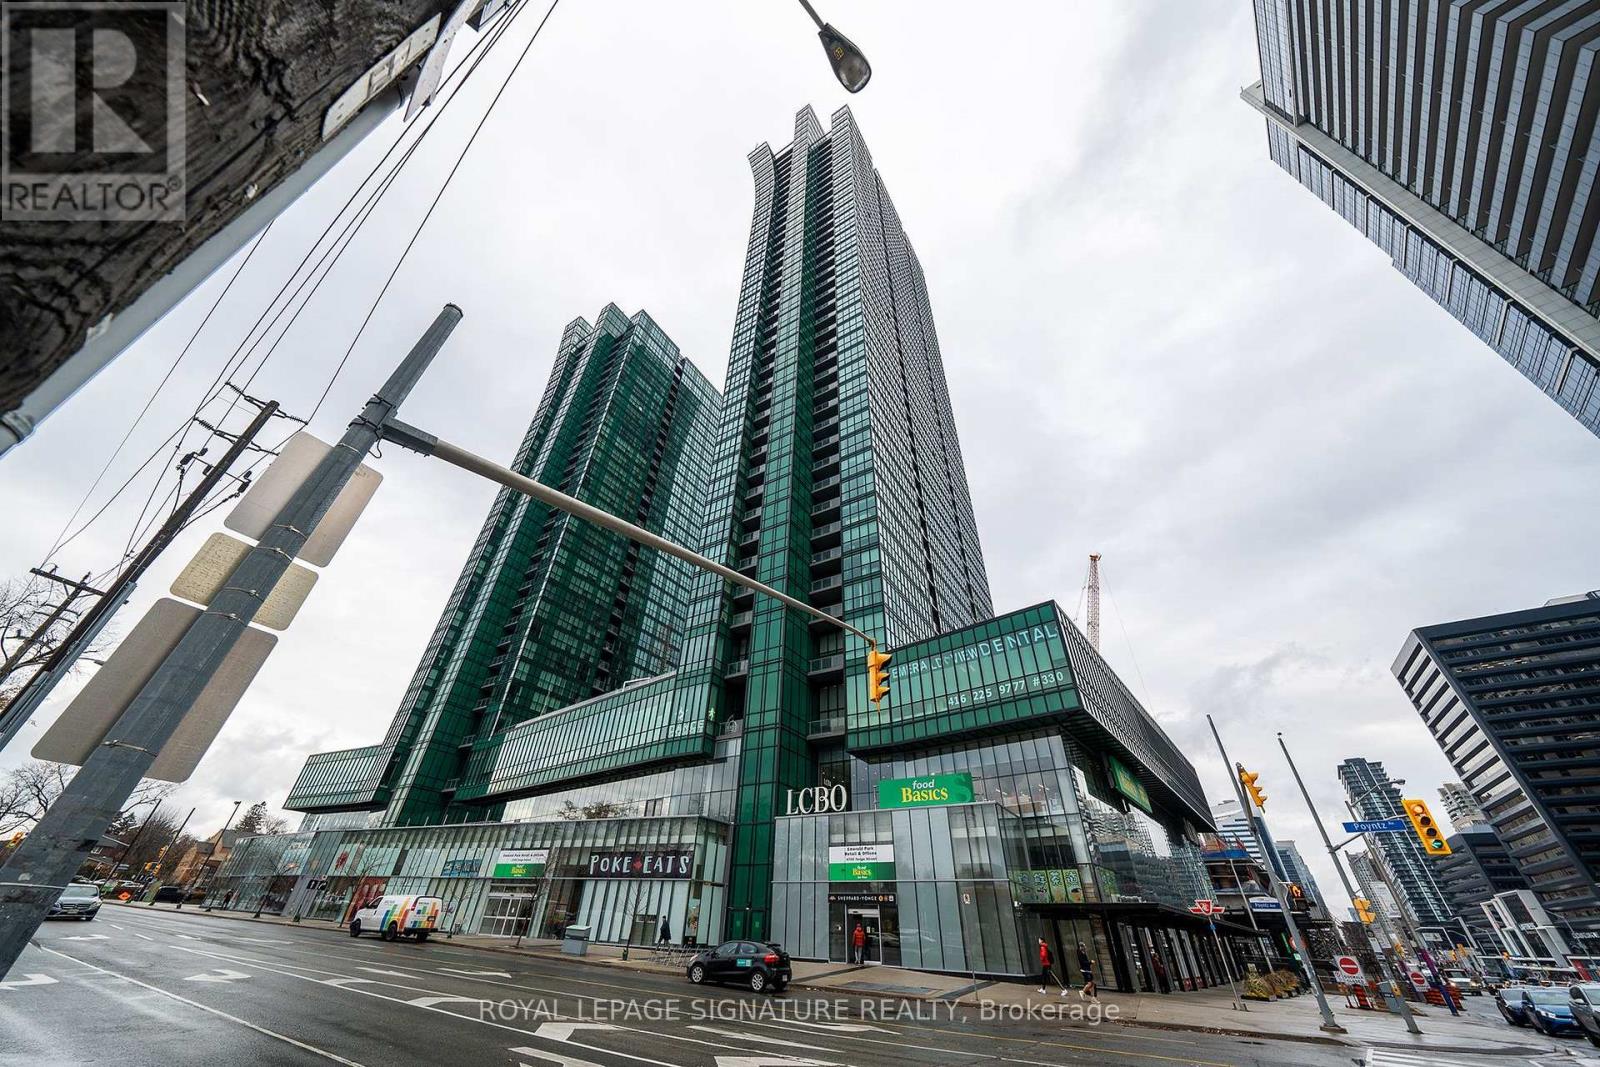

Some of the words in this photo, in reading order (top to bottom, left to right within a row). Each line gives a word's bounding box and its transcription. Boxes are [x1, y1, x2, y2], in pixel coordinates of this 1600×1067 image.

[953, 647, 979, 664] VIEW
[979, 625, 1058, 656] DENTAL
[948, 694, 967, 706] 416
[973, 688, 993, 701] 225
[999, 680, 1025, 695] 9777
[1033, 672, 1064, 687] #330
[912, 779, 935, 790] food
[786, 784, 848, 815] LCBO
[1353, 823, 1388, 832] Poyntz
[590, 855, 632, 875] POKE
[643, 855, 690, 874] EATS
